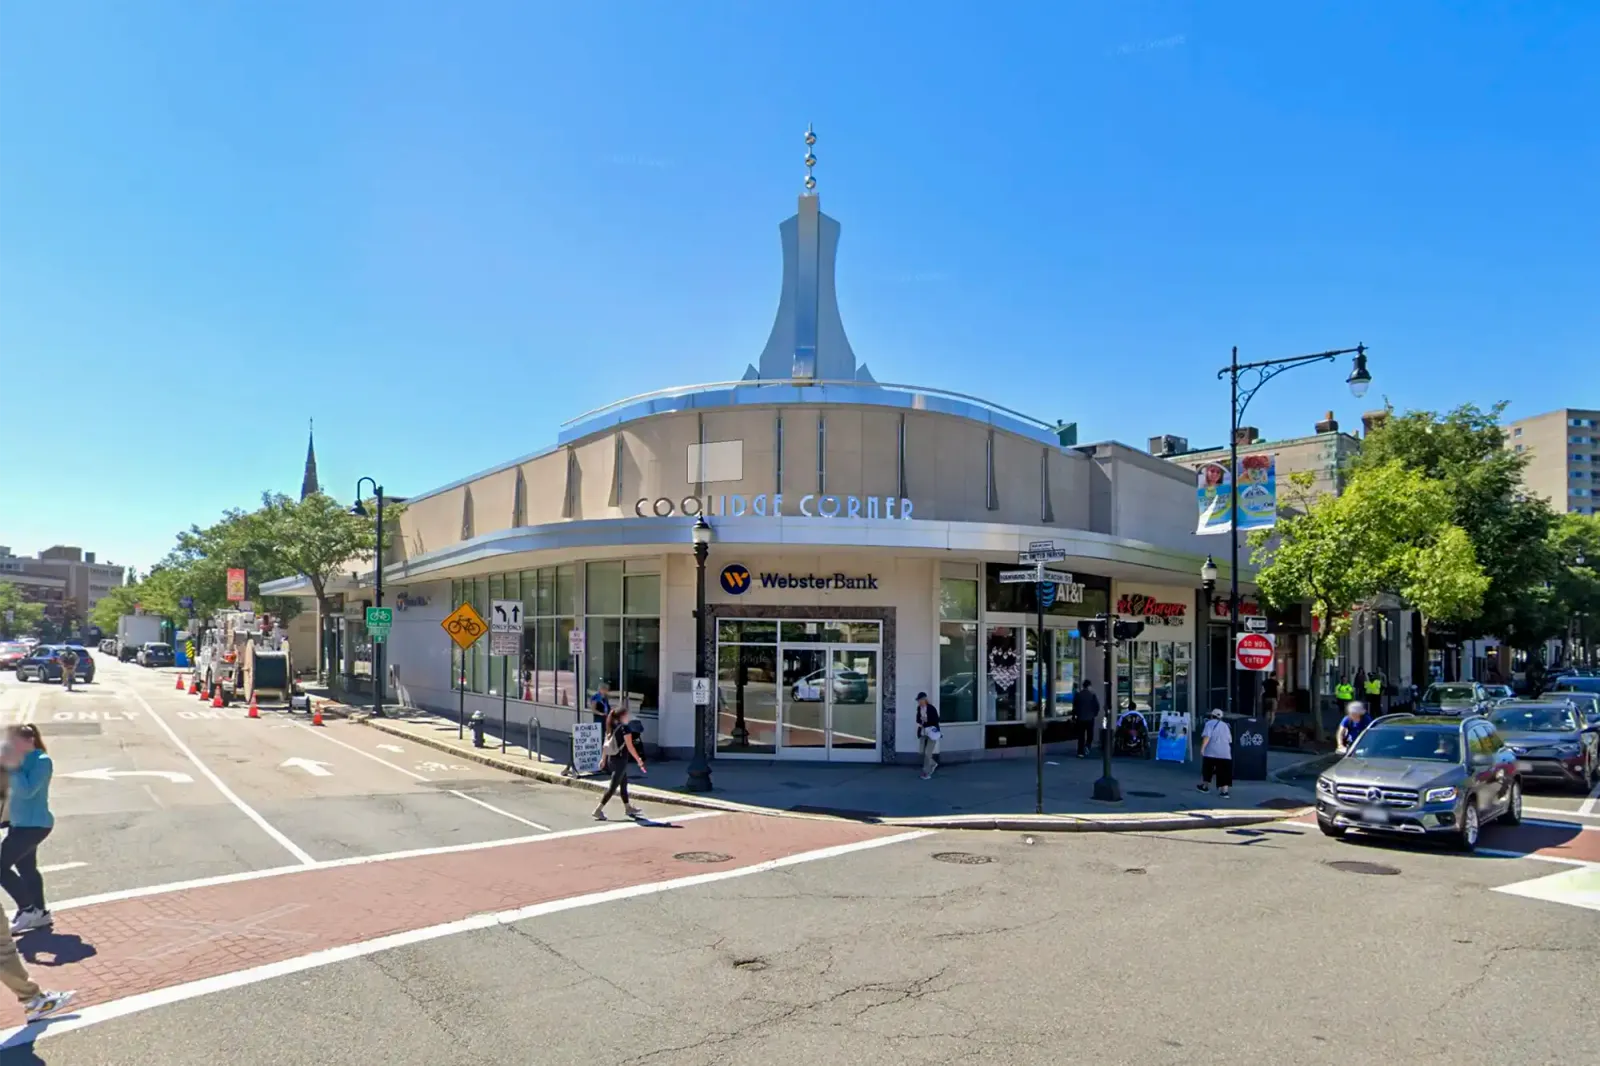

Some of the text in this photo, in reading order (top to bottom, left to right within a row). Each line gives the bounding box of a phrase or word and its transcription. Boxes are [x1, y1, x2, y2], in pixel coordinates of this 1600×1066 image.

[635, 494, 915, 521] COOLIDGE CORNER
[760, 572, 879, 590] WebsterBank
[53, 711, 141, 721] ONLY
